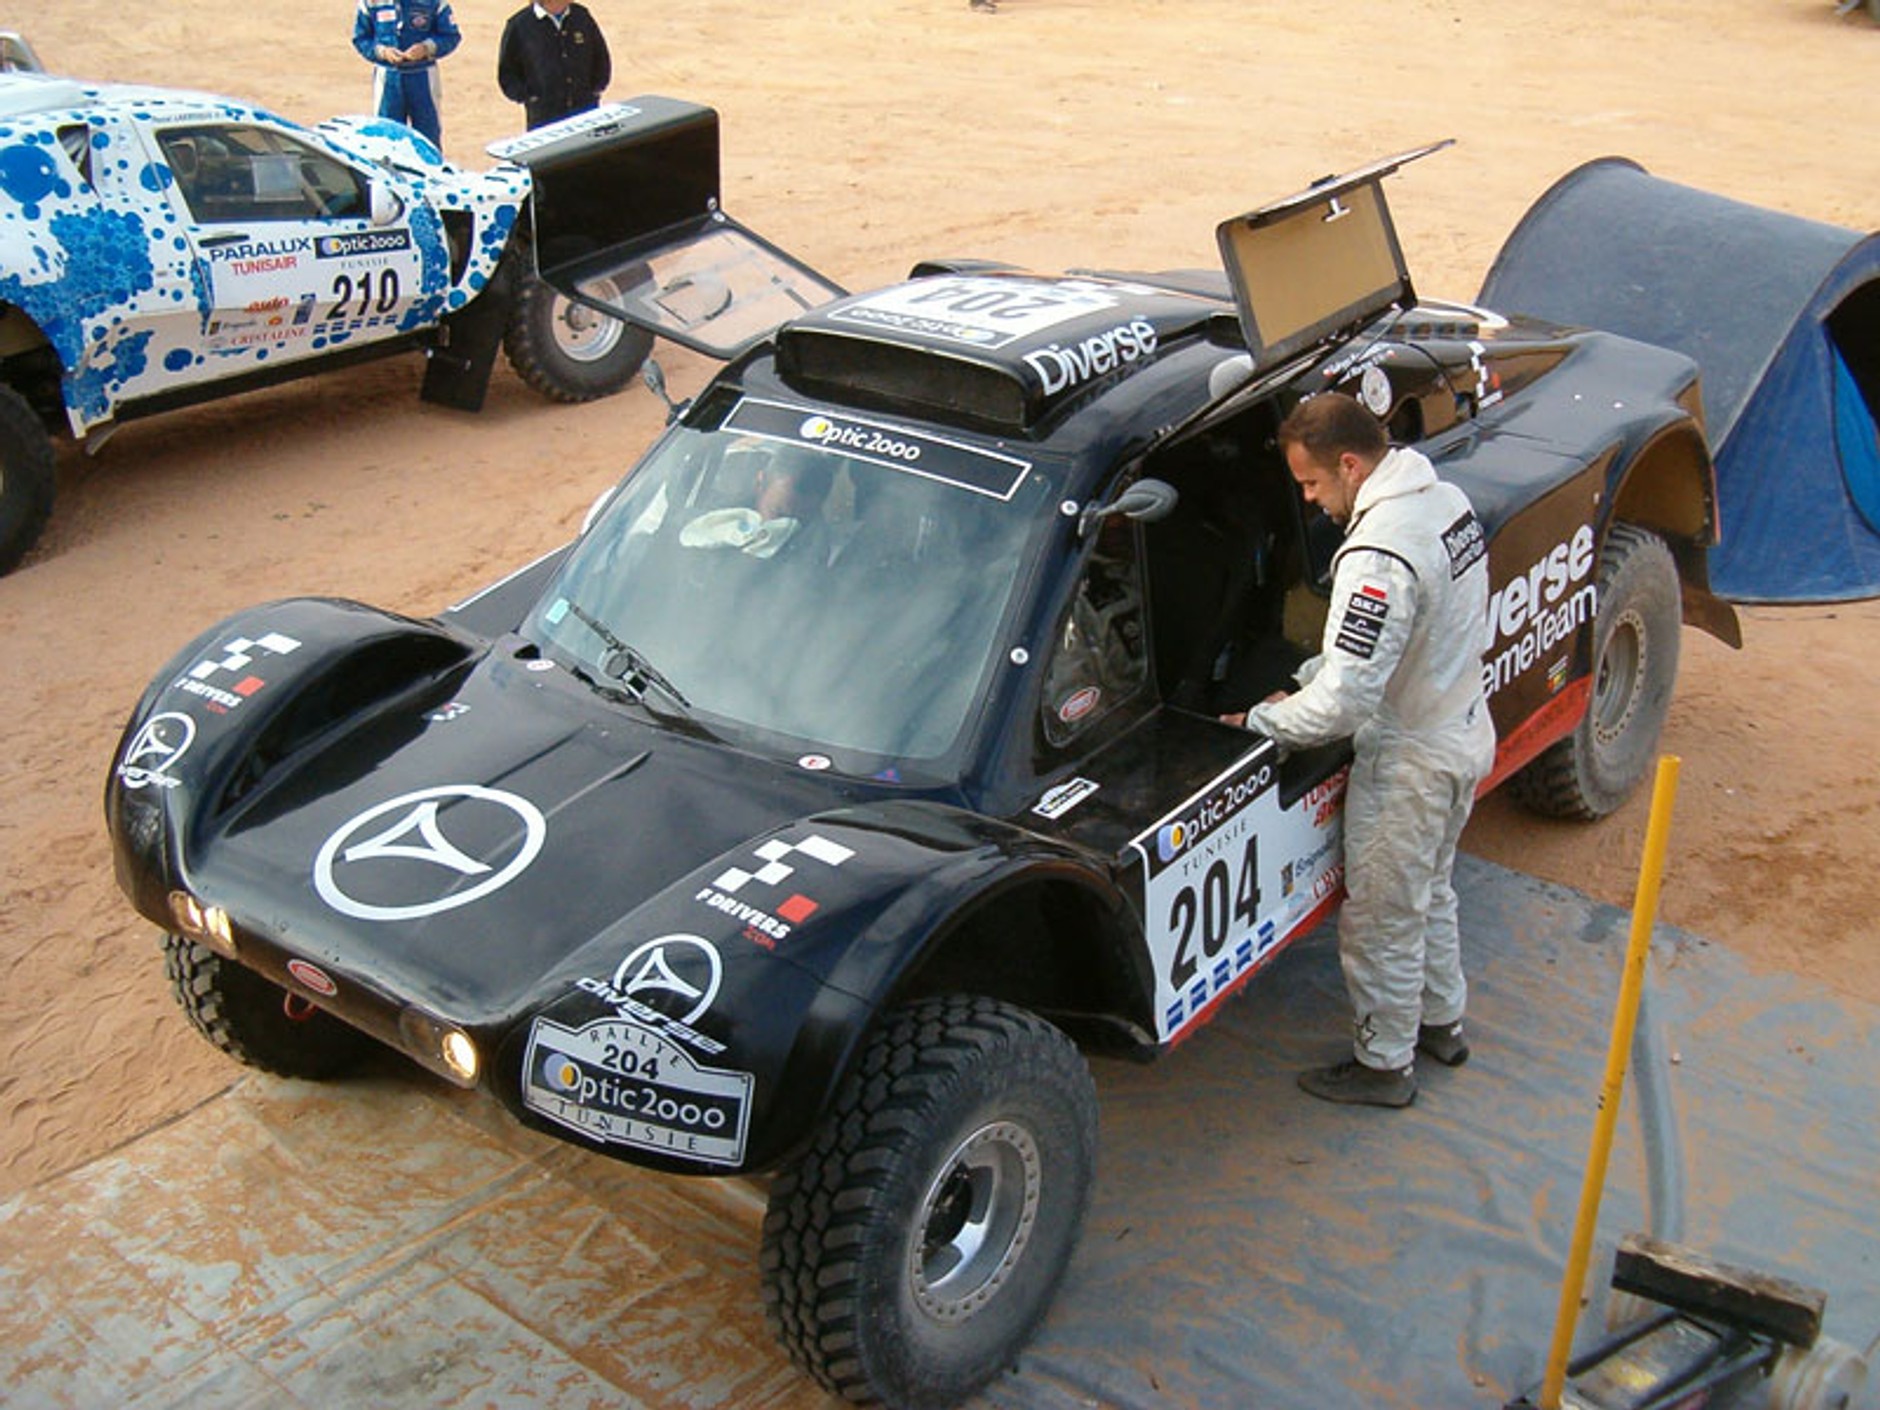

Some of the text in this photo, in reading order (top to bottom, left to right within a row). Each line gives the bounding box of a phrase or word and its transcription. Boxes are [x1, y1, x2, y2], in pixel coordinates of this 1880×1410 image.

[210, 237, 311, 262] PARALUX
[231, 256, 298, 276] TUNISAIR
[326, 268, 399, 320] 210
[1023, 321, 1157, 397] Diverse
[1182, 818, 1246, 875] TUNISIE
[1169, 834, 1261, 992] 204
[576, 977, 727, 1054] diverse
[590, 1026, 683, 1068] RALLYE
[602, 1044, 660, 1080] 204
[559, 1101, 698, 1149] TUNISIE
